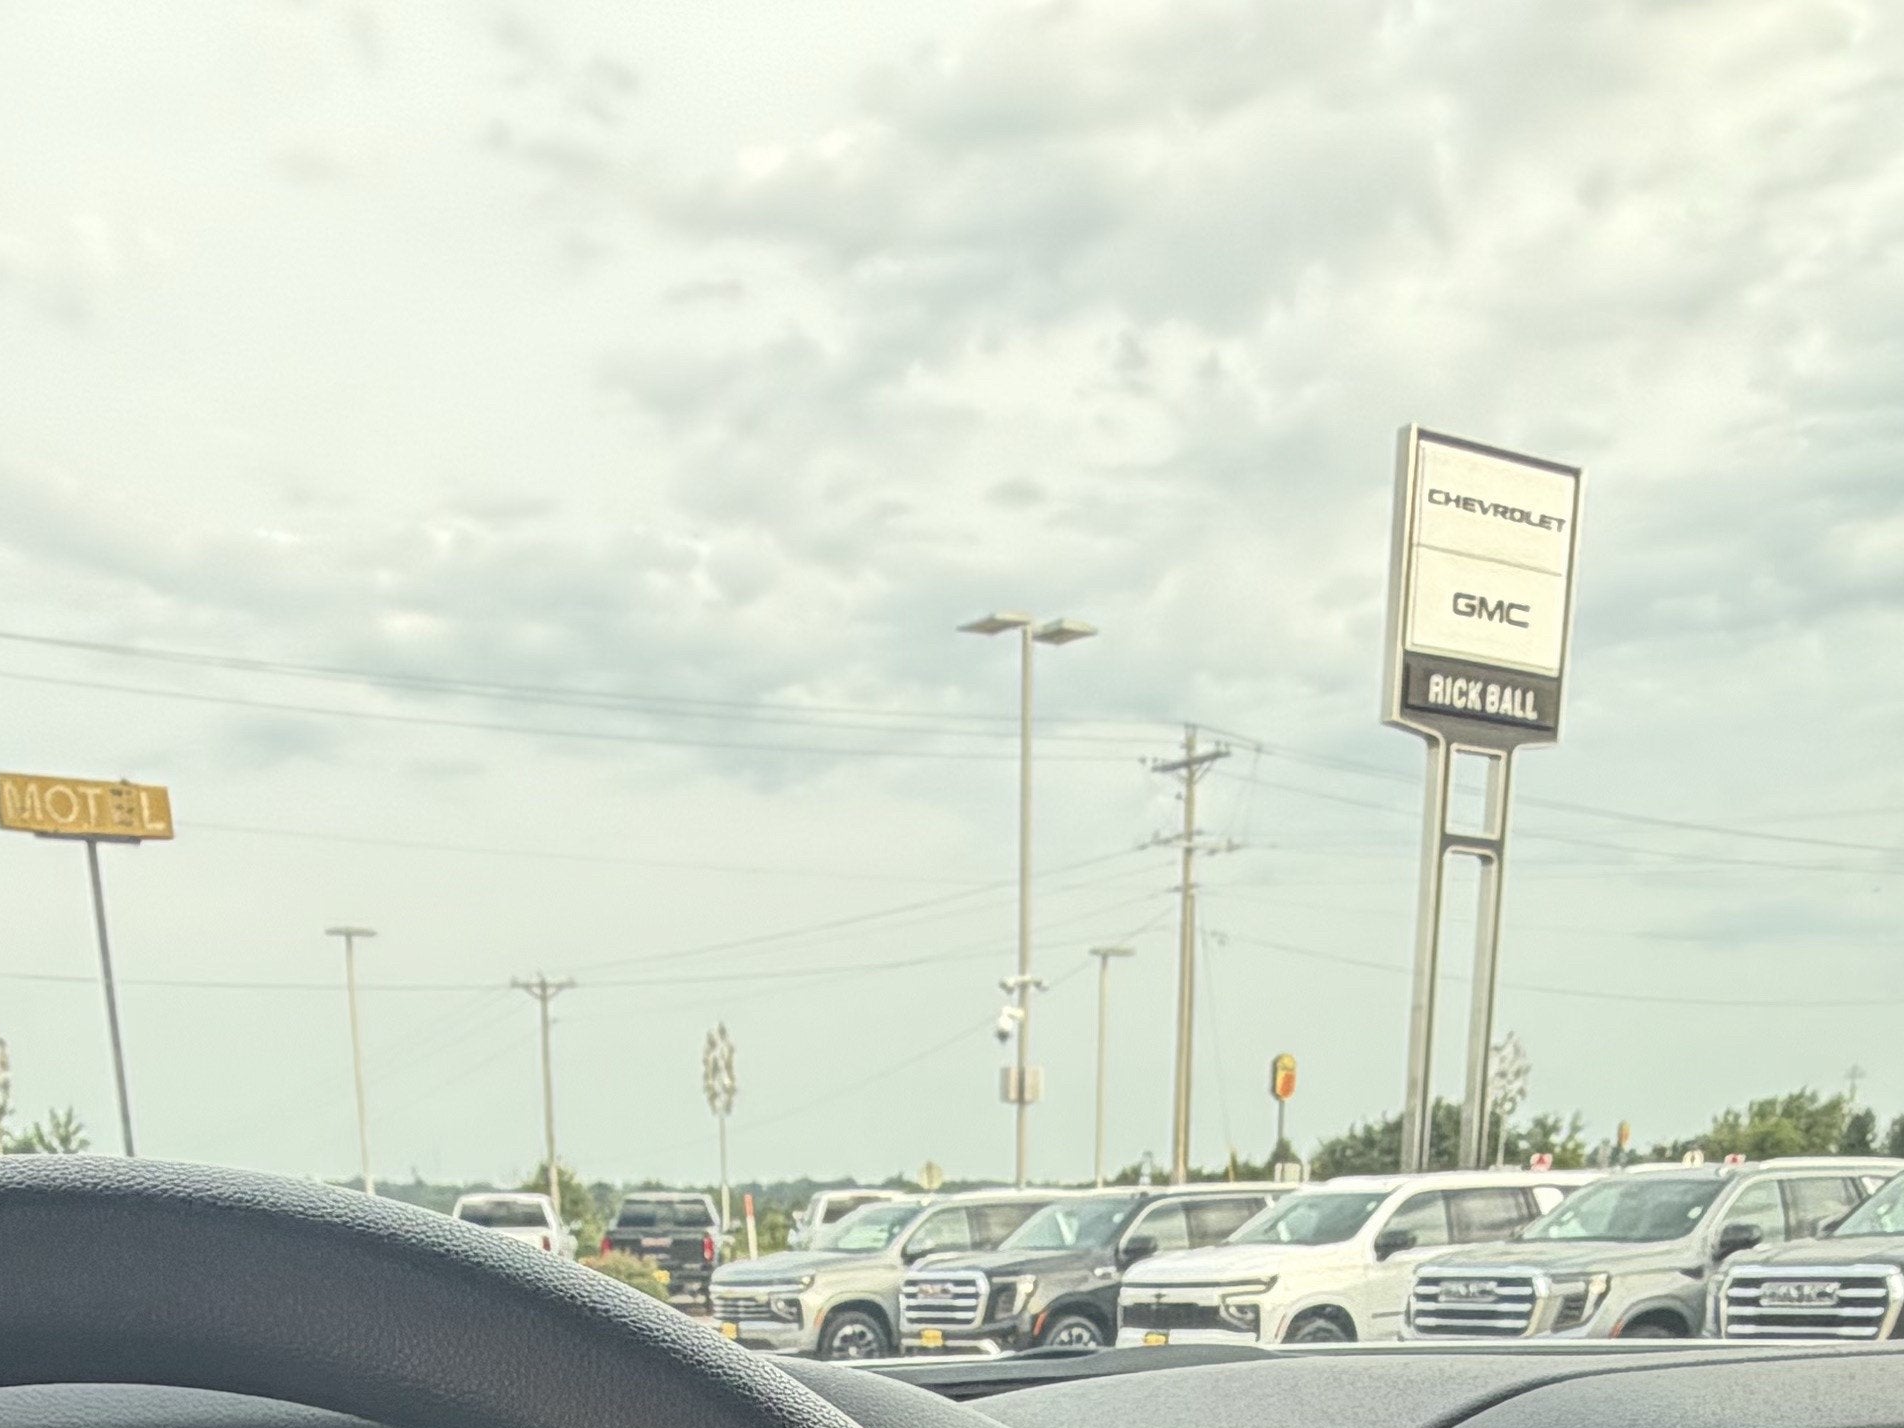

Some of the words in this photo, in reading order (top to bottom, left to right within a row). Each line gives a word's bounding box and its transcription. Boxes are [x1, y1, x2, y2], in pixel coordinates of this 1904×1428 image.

[1427, 488, 1567, 533] CHEVROLET
[1452, 592, 1531, 628] GMC
[1428, 673, 1482, 712] RICK
[1485, 683, 1538, 720] BALL
